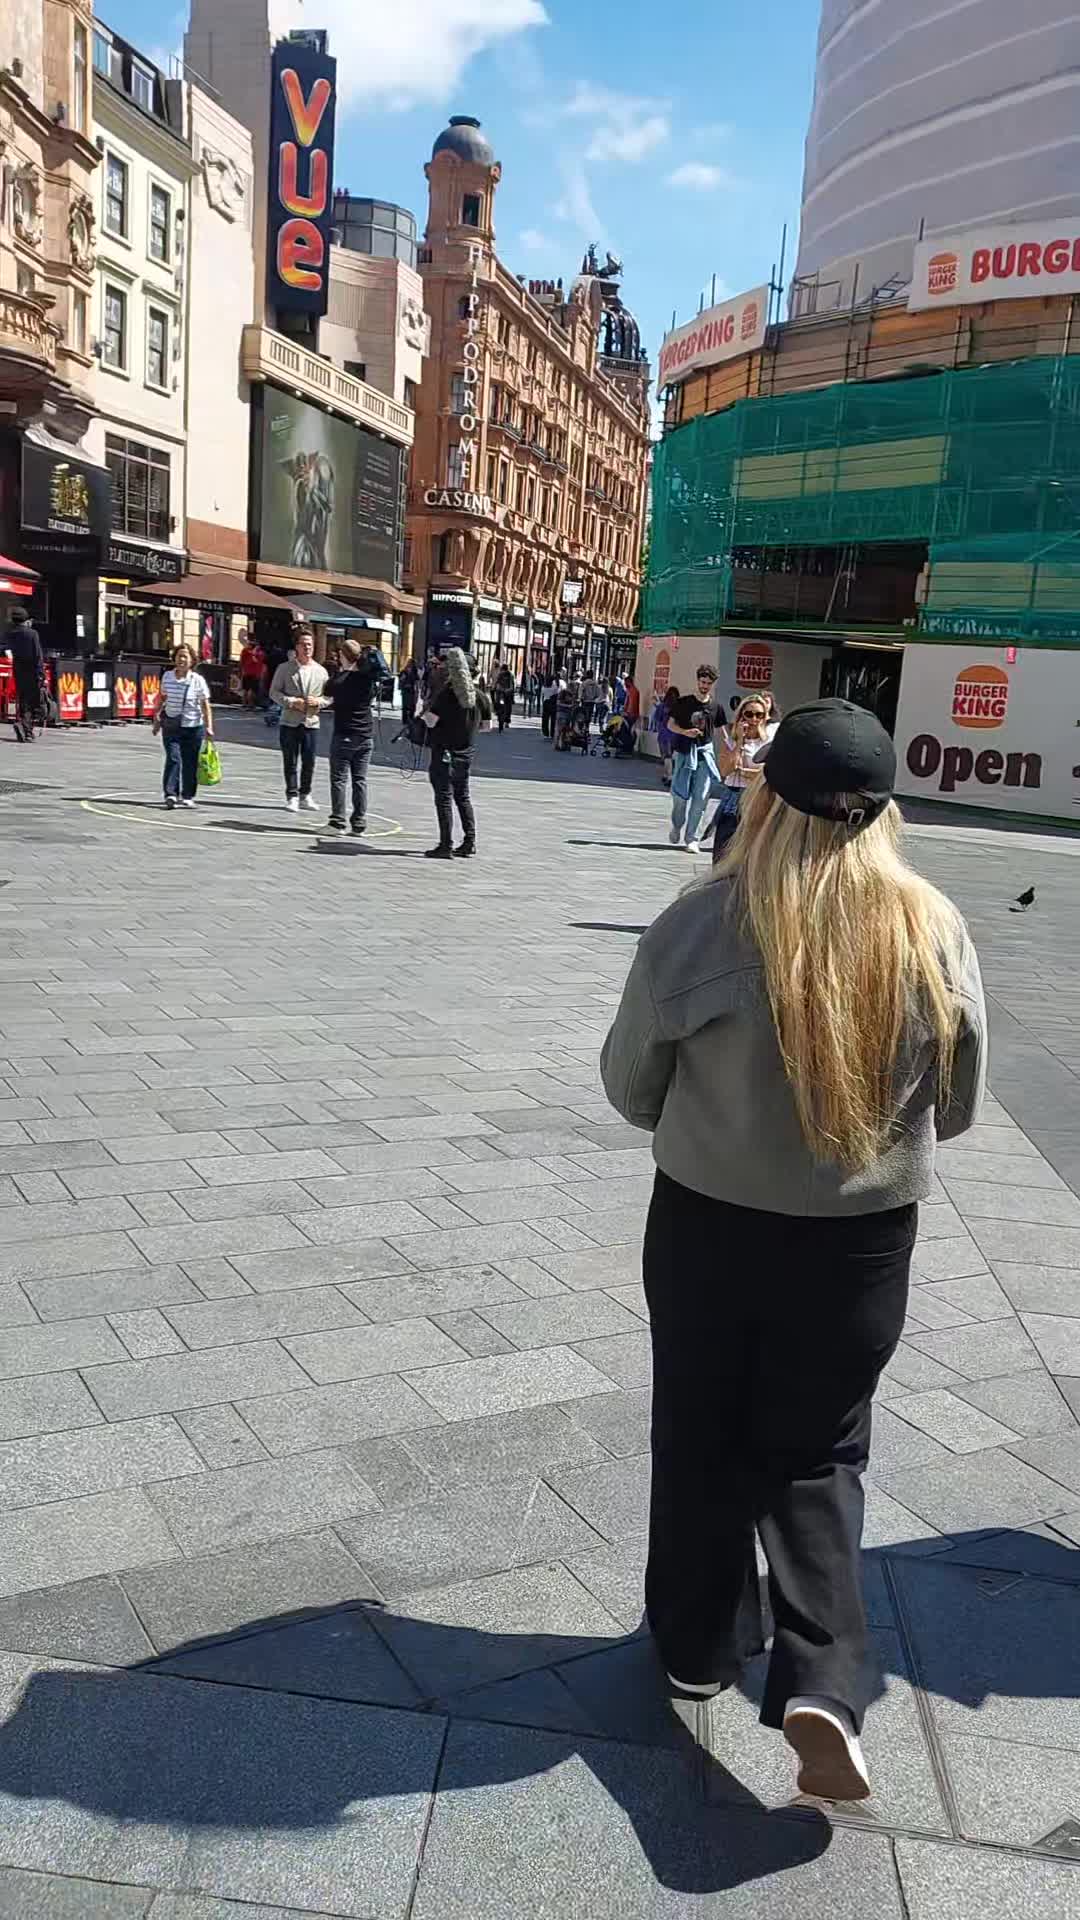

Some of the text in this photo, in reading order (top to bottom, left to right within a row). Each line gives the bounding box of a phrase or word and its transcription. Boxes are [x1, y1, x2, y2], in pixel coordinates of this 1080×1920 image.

[928, 272, 957, 289] KING
[698, 315, 735, 349] KING
[457, 246, 483, 478] HIPPODROME
[424, 489, 491, 512] CASINO
[162, 598, 257, 614] PIZZA PASTA GRILL
[736, 656, 773, 668] BURGER
[736, 666, 773, 681] KING
[953, 683, 1008, 699] BURGER
[952, 697, 1006, 717] KING
[906, 734, 1042, 792] Open
